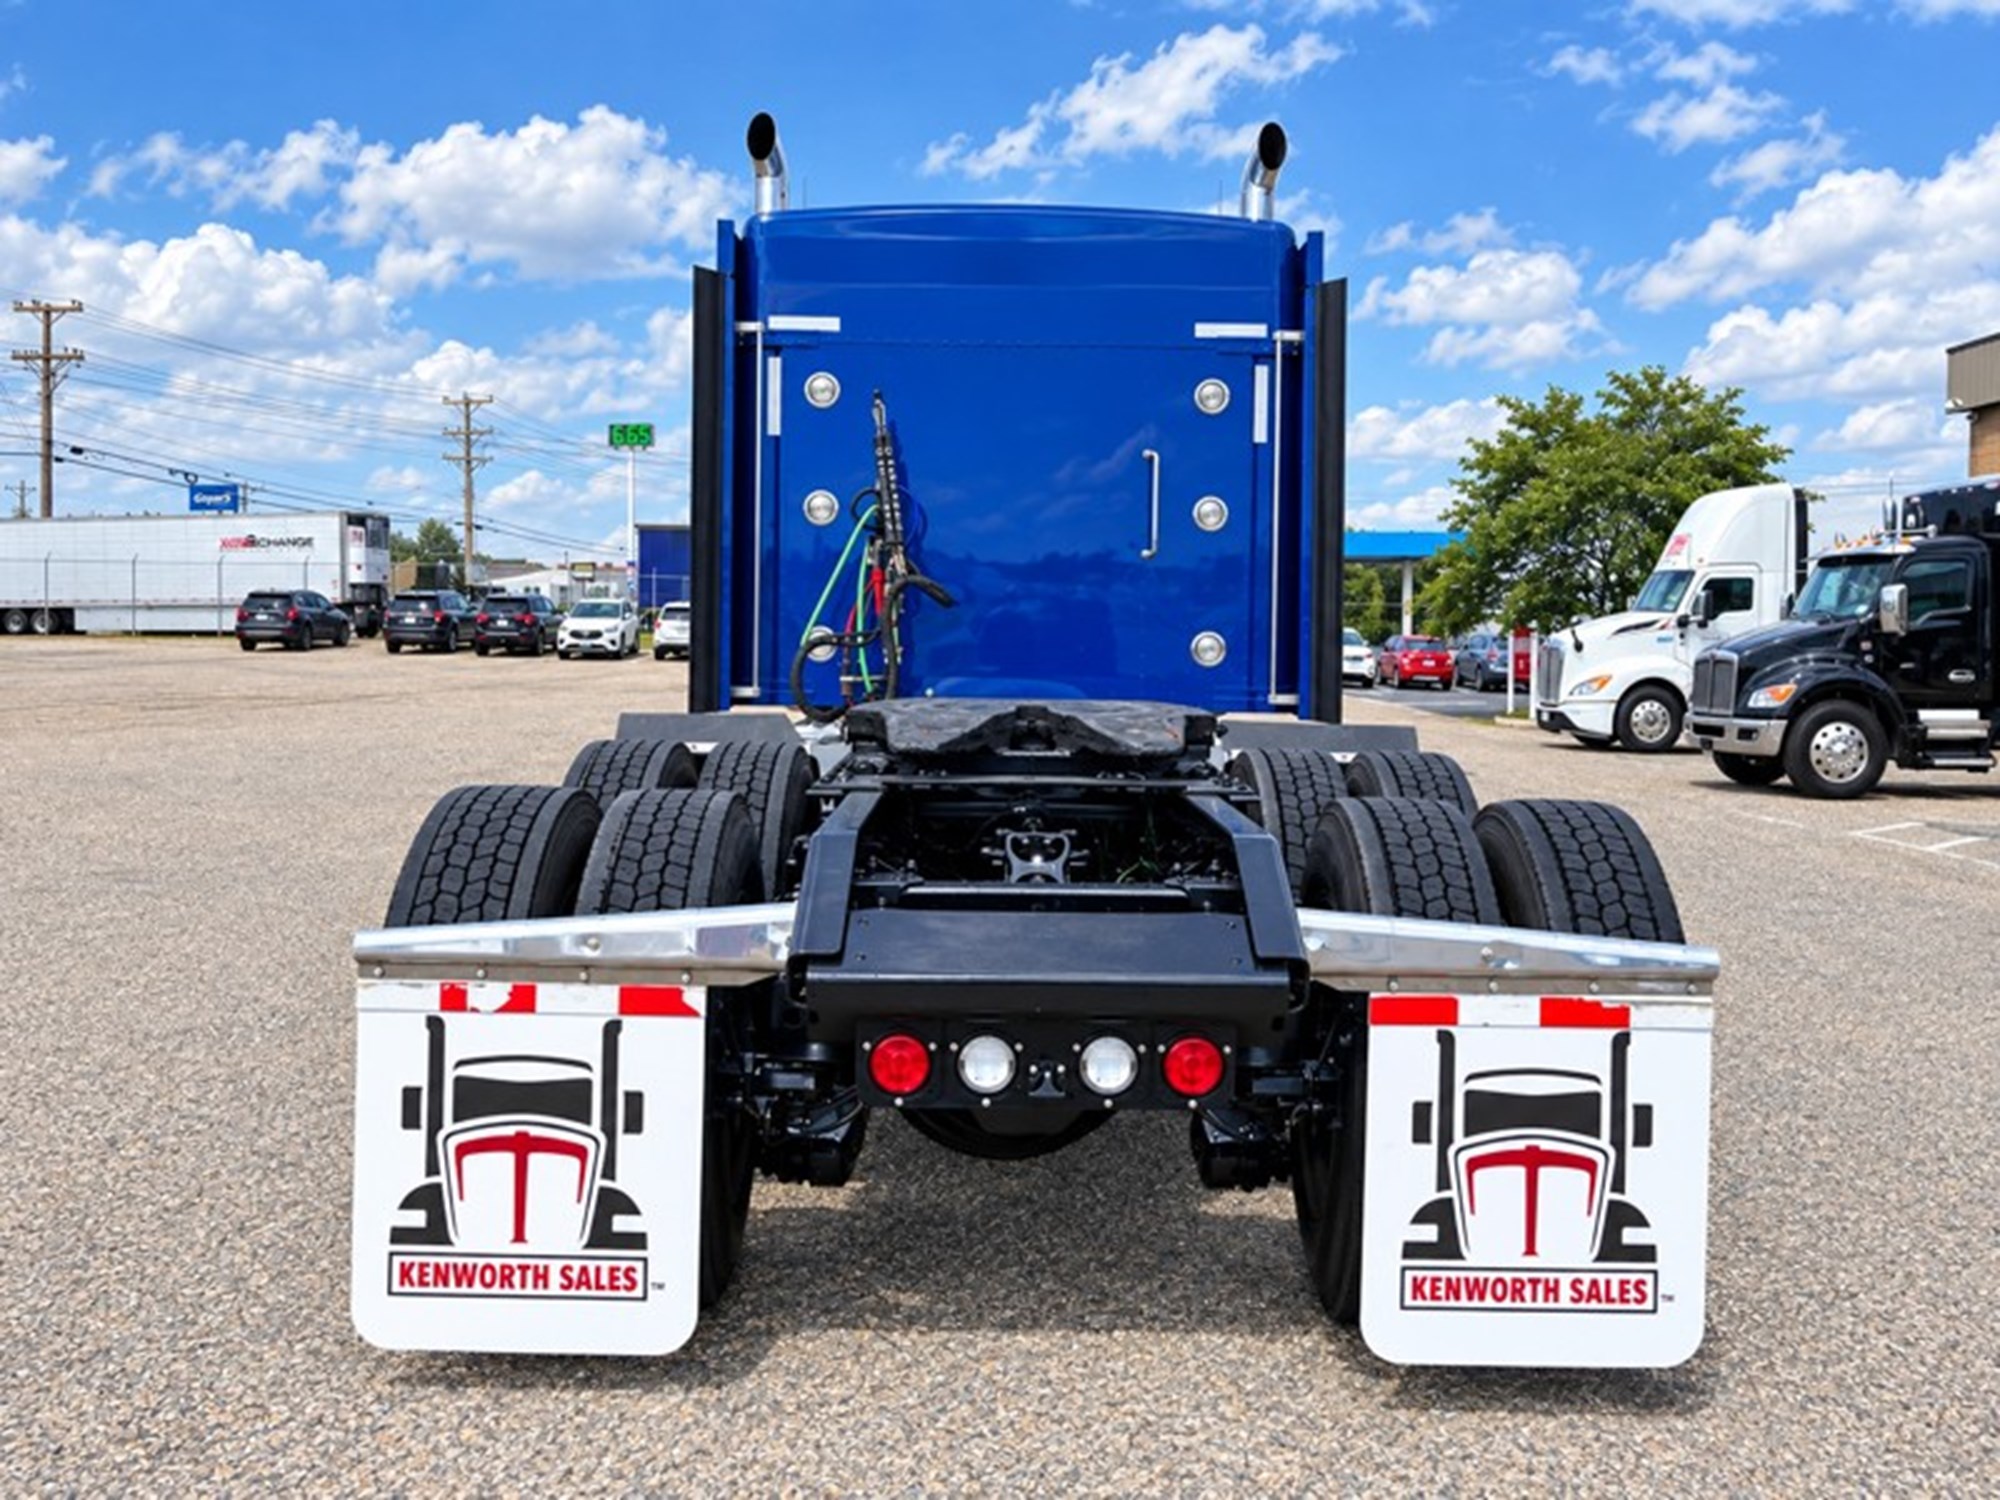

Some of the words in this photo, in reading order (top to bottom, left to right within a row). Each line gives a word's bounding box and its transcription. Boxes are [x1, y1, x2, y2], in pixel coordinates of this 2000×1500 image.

[398, 1261, 550, 1291] KENWORTH
[559, 1264, 638, 1292] SALES
[1411, 1276, 1561, 1304] KENWORTH
[1569, 1278, 1648, 1305] SALES
